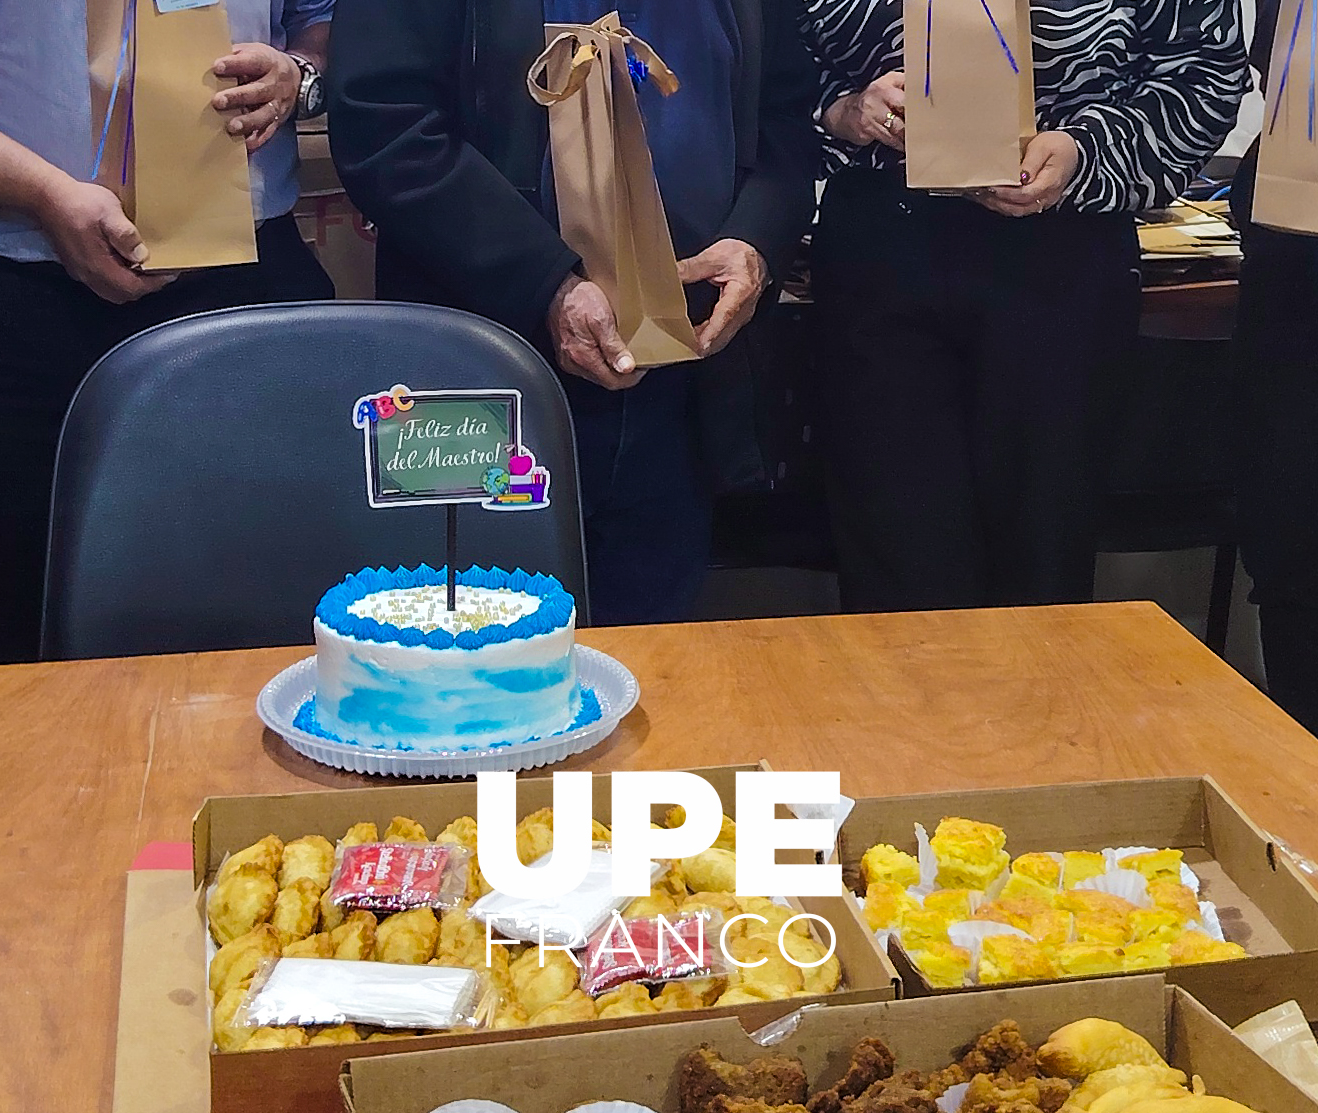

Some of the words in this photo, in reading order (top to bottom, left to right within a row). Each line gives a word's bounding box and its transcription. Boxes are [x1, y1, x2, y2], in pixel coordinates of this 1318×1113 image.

[357, 389, 415, 424] ABC
[397, 418, 452, 450] ¡Feliz
[456, 417, 489, 436] día
[386, 450, 419, 472] del
[417, 442, 502, 470] Maestro!
